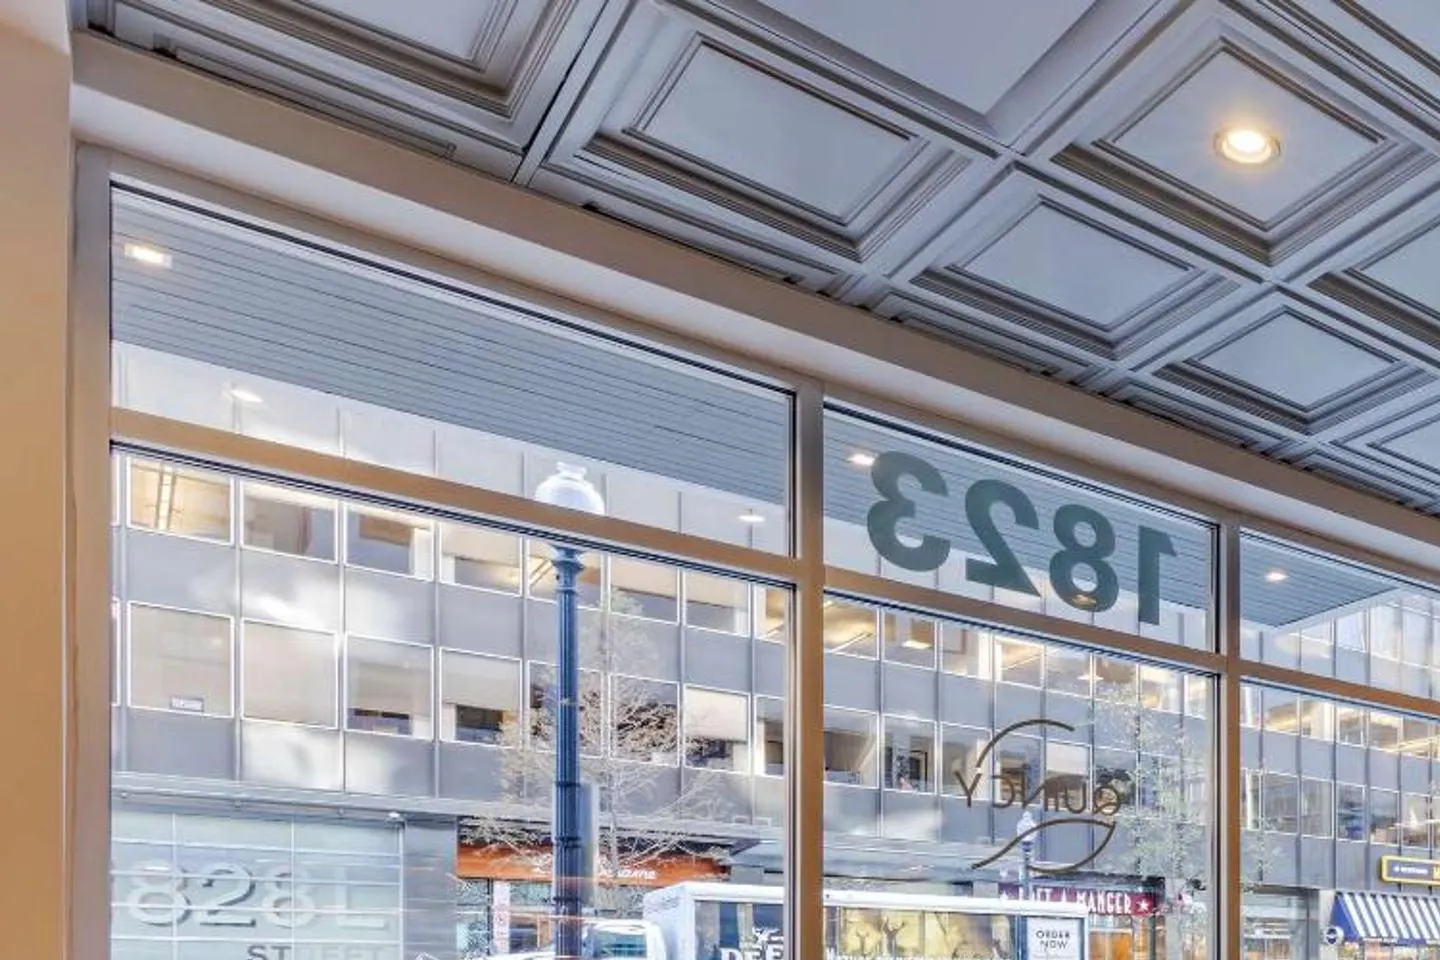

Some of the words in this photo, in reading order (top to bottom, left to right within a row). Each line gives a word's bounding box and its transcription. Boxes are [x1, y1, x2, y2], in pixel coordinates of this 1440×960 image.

[1076, 890, 1132, 914] MANGER
[1035, 930, 1071, 939] ORDER
[1040, 940, 1068, 949] NOW
